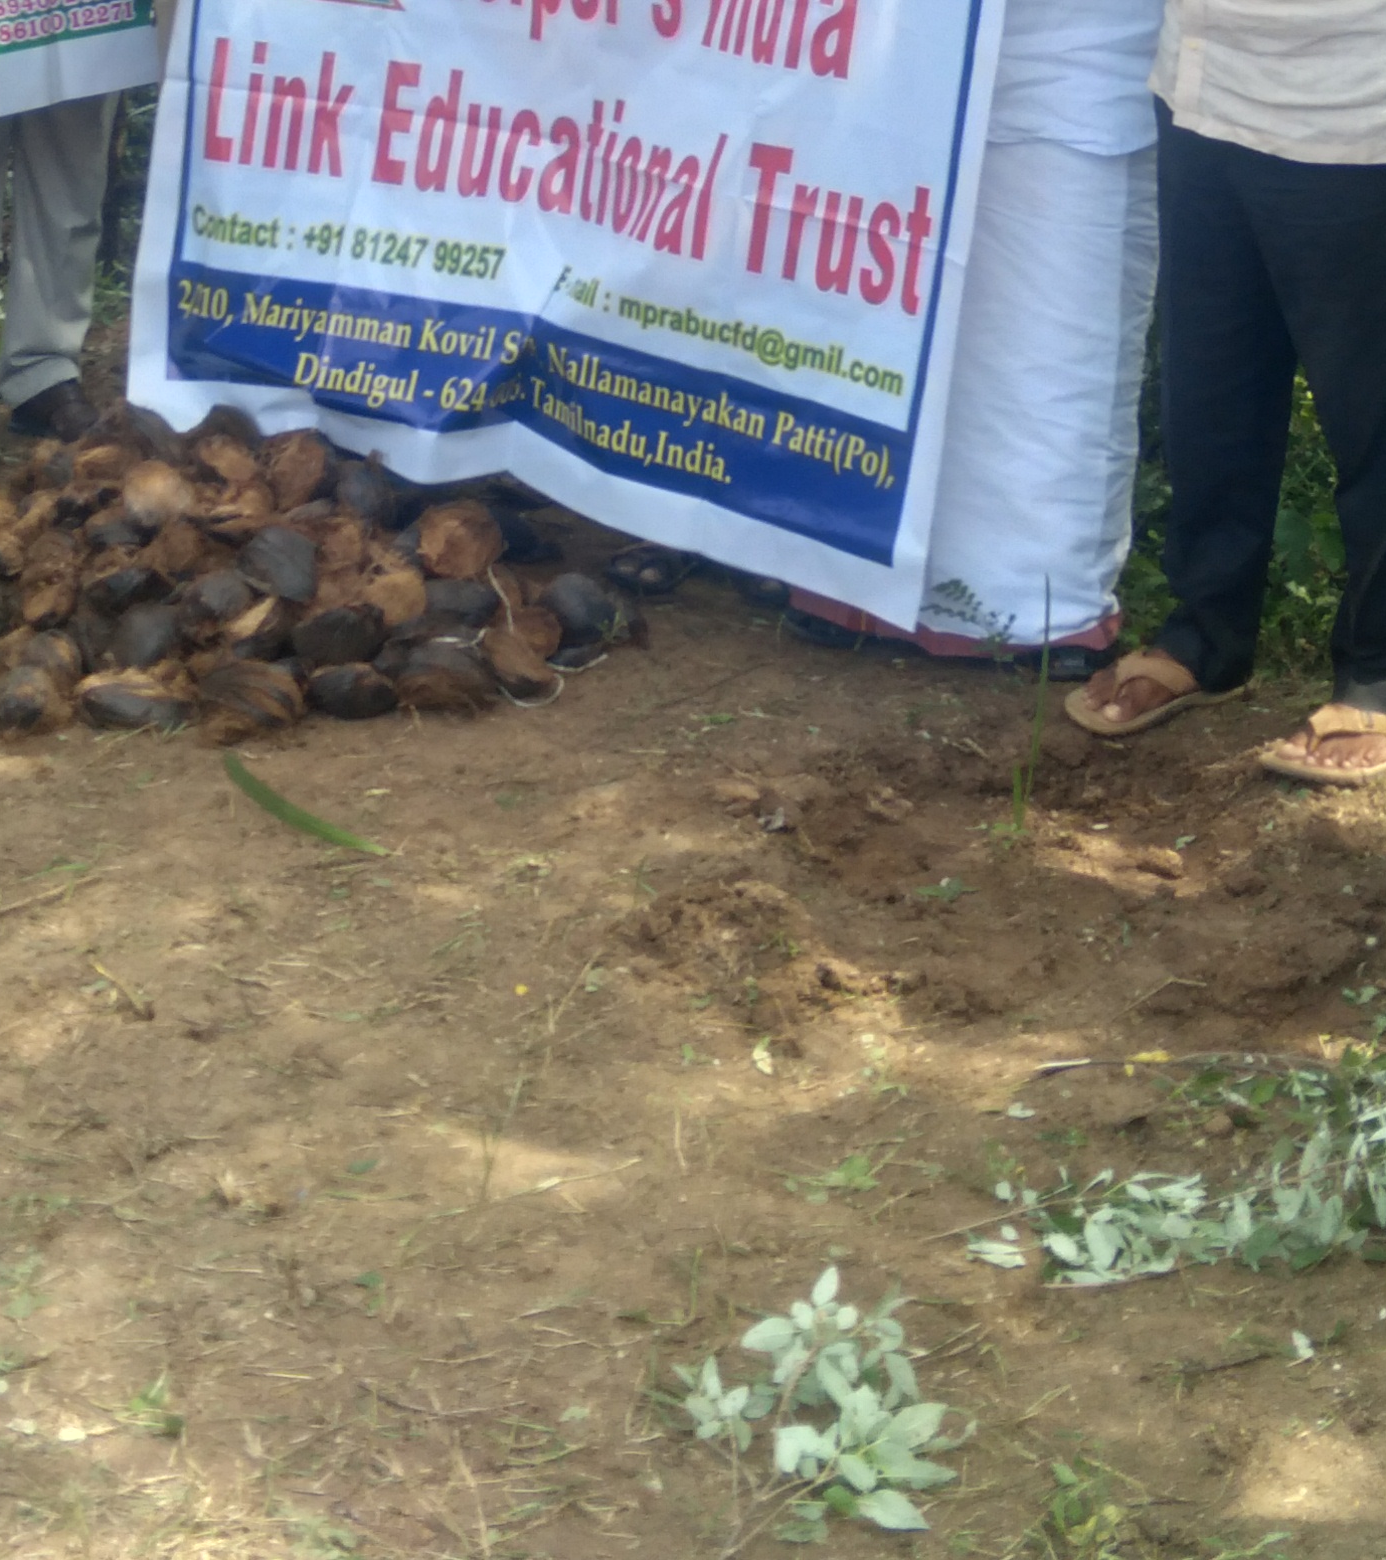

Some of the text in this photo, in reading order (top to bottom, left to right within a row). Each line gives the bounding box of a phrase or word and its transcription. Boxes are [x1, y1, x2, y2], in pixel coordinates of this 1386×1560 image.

[70, 1, 134, 29] 12271
[202, 37, 932, 317] Link Educational Trust
[191, 204, 280, 250] Contact
[303, 223, 345, 258] +91
[351, 228, 428, 269] 81247
[432, 239, 507, 281] 99257
[240, 291, 412, 350] Mariyamman
[417, 314, 496, 361] Kovil
[548, 340, 765, 440] Nallamanayakan
[772, 409, 895, 490] Patti(Po),
[618, 293, 904, 396] mprabucfd@gmil.com
[293, 351, 418, 409] Dindigul
[440, 376, 488, 413] 624
[529, 375, 733, 485] Tamilnadu,India.
